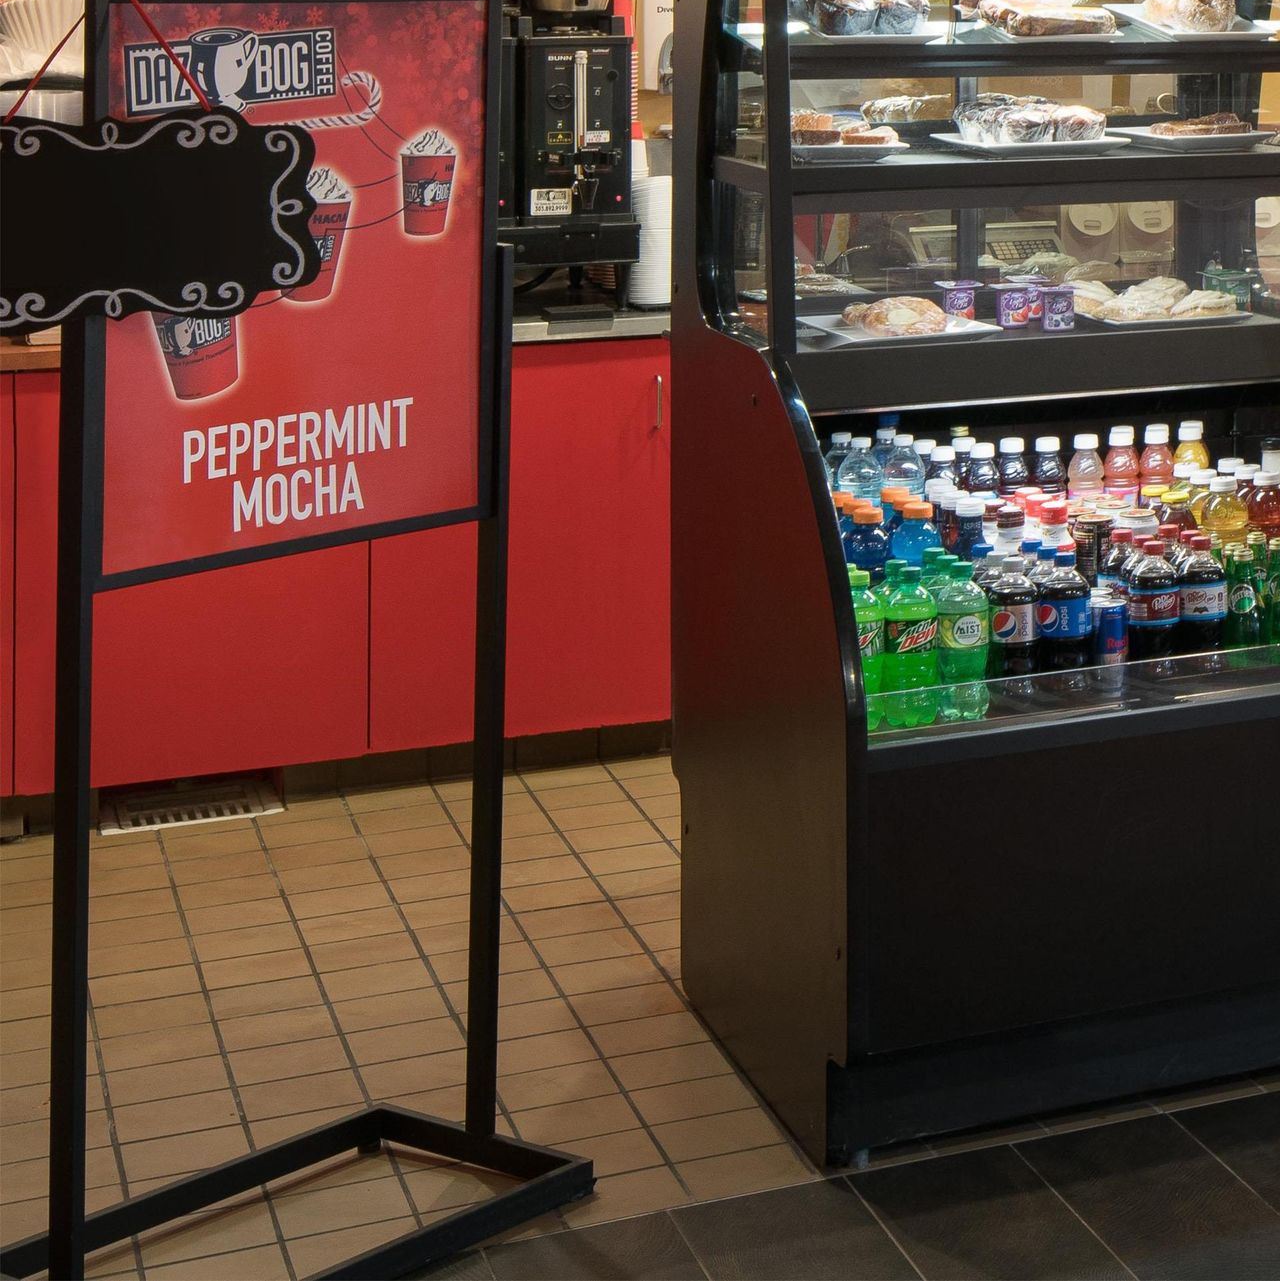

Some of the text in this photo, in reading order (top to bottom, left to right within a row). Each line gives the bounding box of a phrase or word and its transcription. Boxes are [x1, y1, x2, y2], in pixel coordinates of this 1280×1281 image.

[132, 30, 334, 104] DAZ BOG COFFEE
[326, 235, 335, 262] COFFEE
[182, 397, 414, 484] PEPPERMINT
[232, 462, 365, 532] MOCHA
[963, 521, 981, 530] ASPIRE
[956, 625, 980, 634] MIST
[1021, 611, 1029, 637] pepsi
[1061, 606, 1069, 630] pepsi
